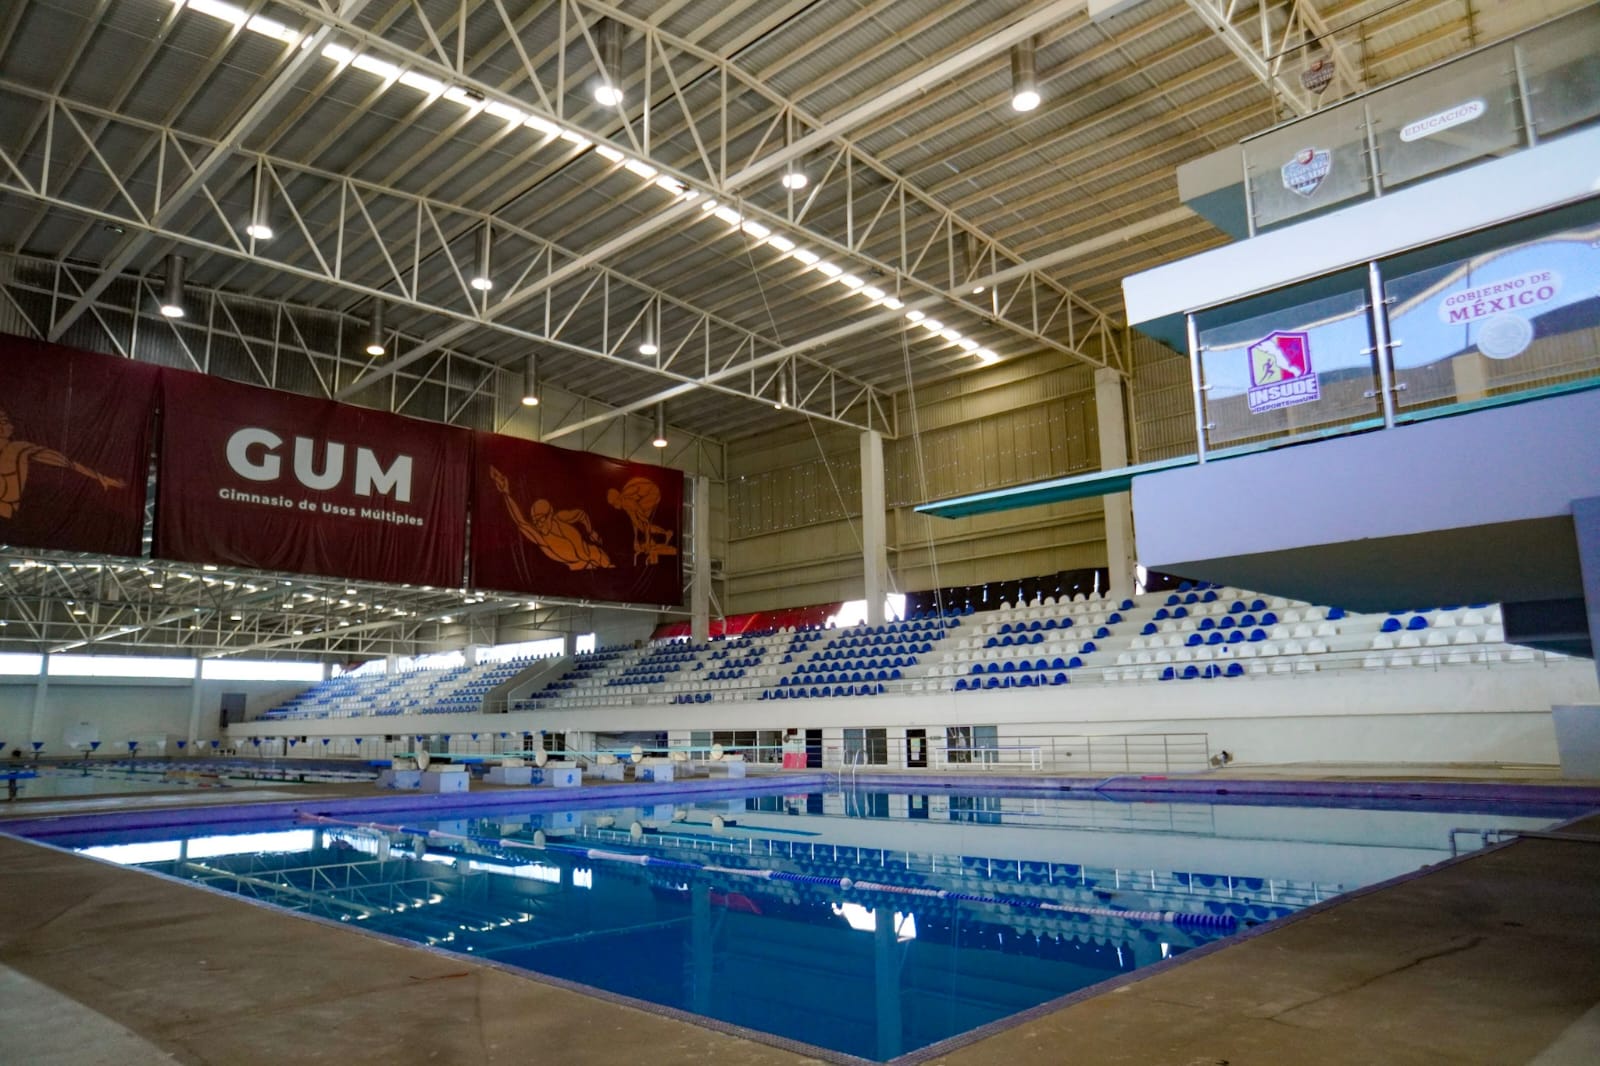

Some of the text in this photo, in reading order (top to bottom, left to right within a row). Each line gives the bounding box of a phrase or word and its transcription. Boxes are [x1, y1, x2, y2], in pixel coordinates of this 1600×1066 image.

[1445, 271, 1551, 306] GOBIERNO DE
[1449, 286, 1554, 323] MÉXICO
[1249, 378, 1318, 407] INSUDE
[226, 427, 413, 503] GUM
[219, 488, 424, 526] Gimnasio de Usos Múltiples
